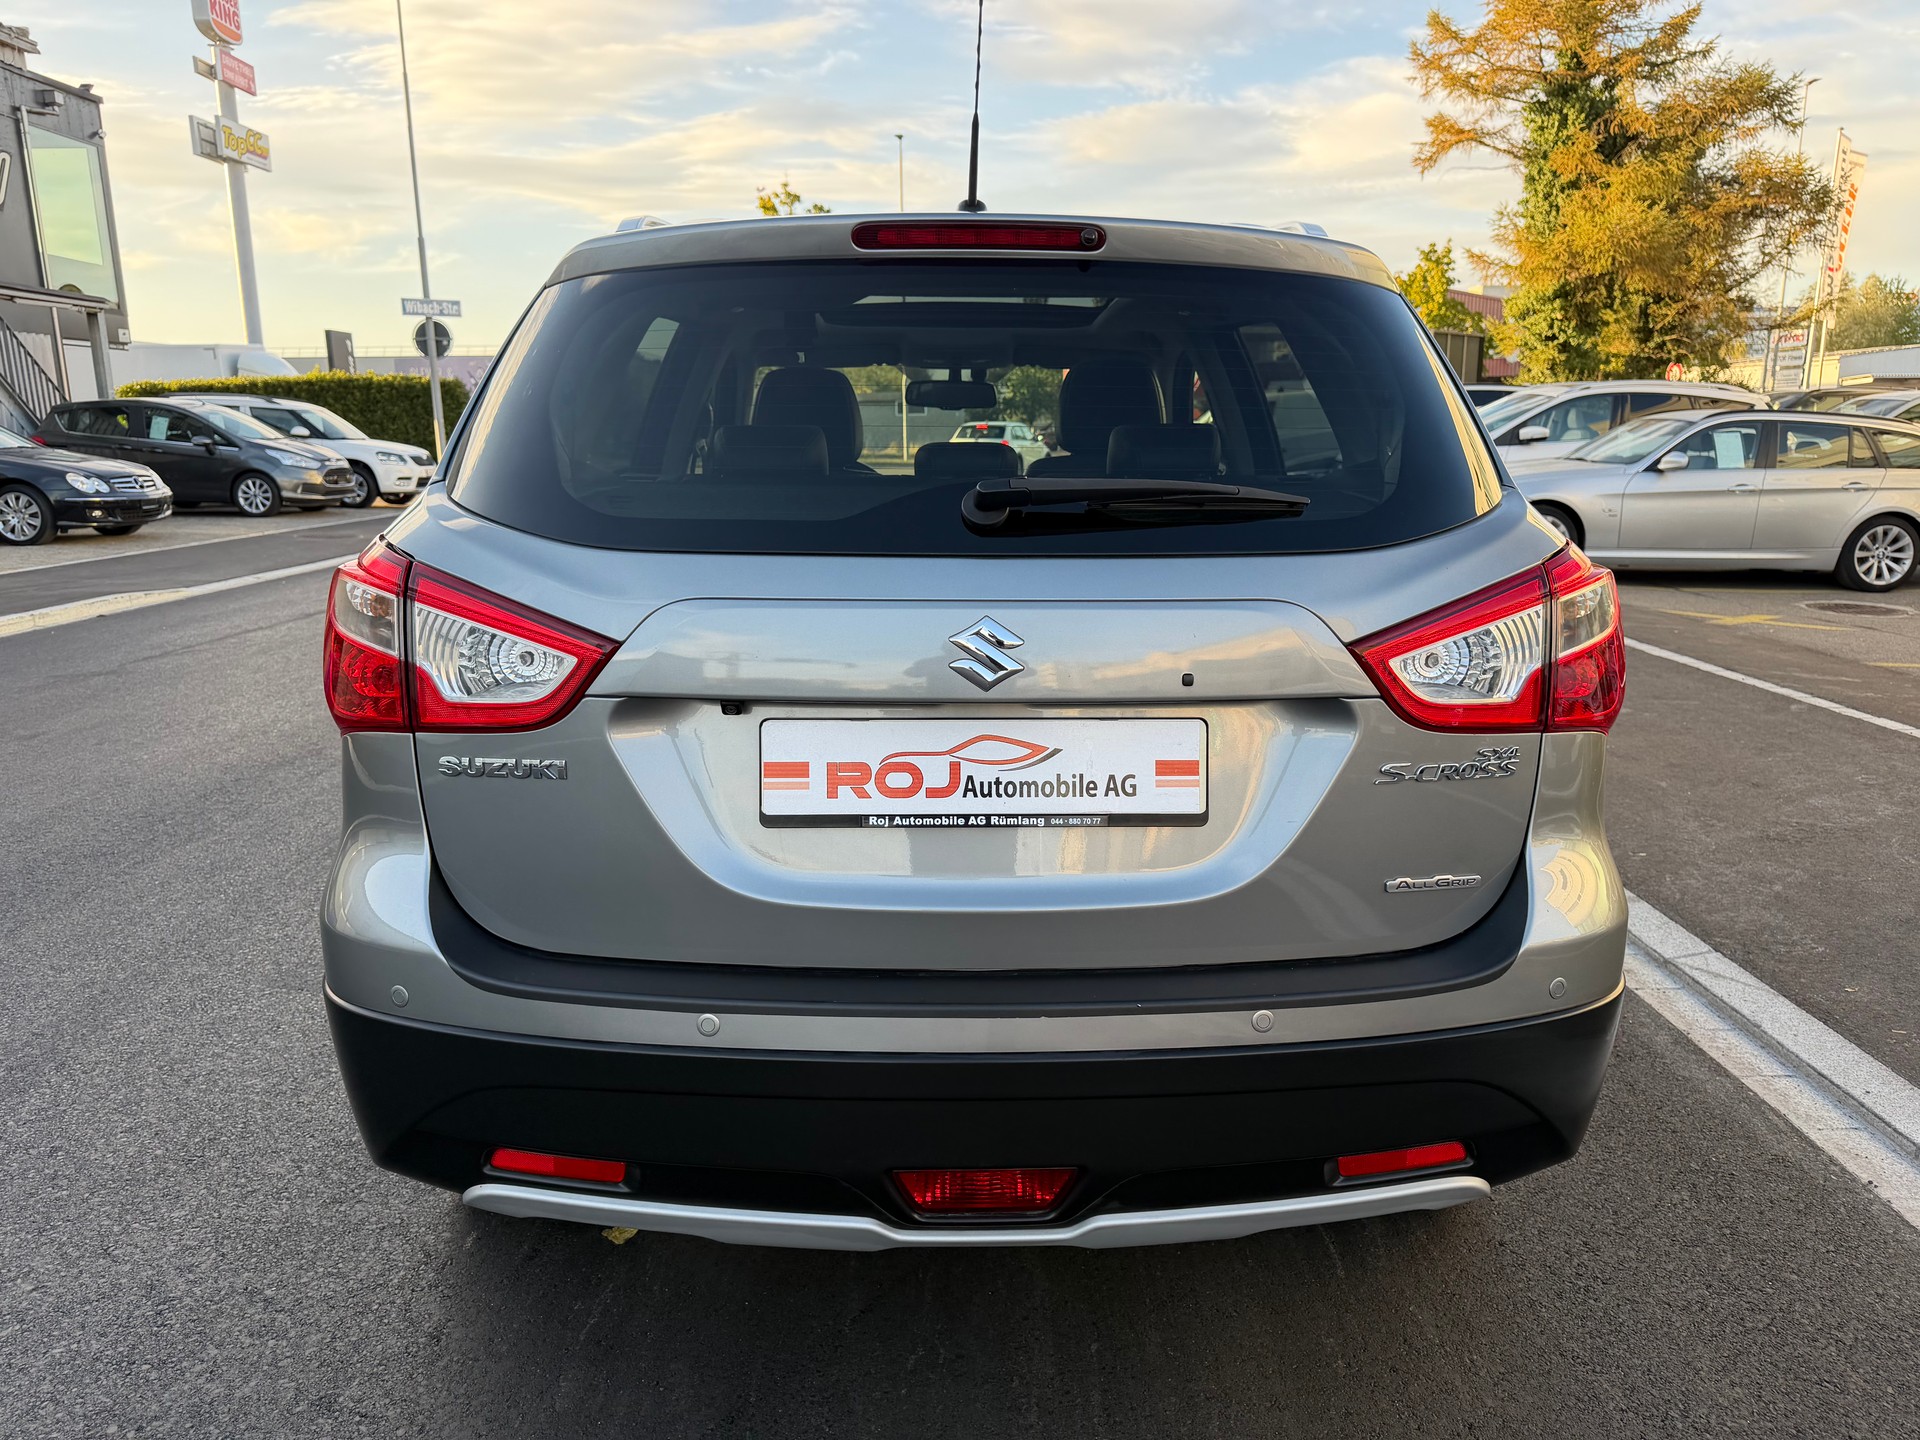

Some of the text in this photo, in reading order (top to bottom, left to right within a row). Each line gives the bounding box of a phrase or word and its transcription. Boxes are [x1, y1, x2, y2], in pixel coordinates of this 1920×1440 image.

[1474, 745, 1520, 762] SX4
[438, 756, 568, 780] SUZUKI
[826, 761, 1138, 799] ROJ Automobile AG
[869, 816, 889, 827] Roj
[893, 816, 966, 825] Automobile
[968, 816, 987, 825] AG
[990, 816, 1045, 827] Rümlang
